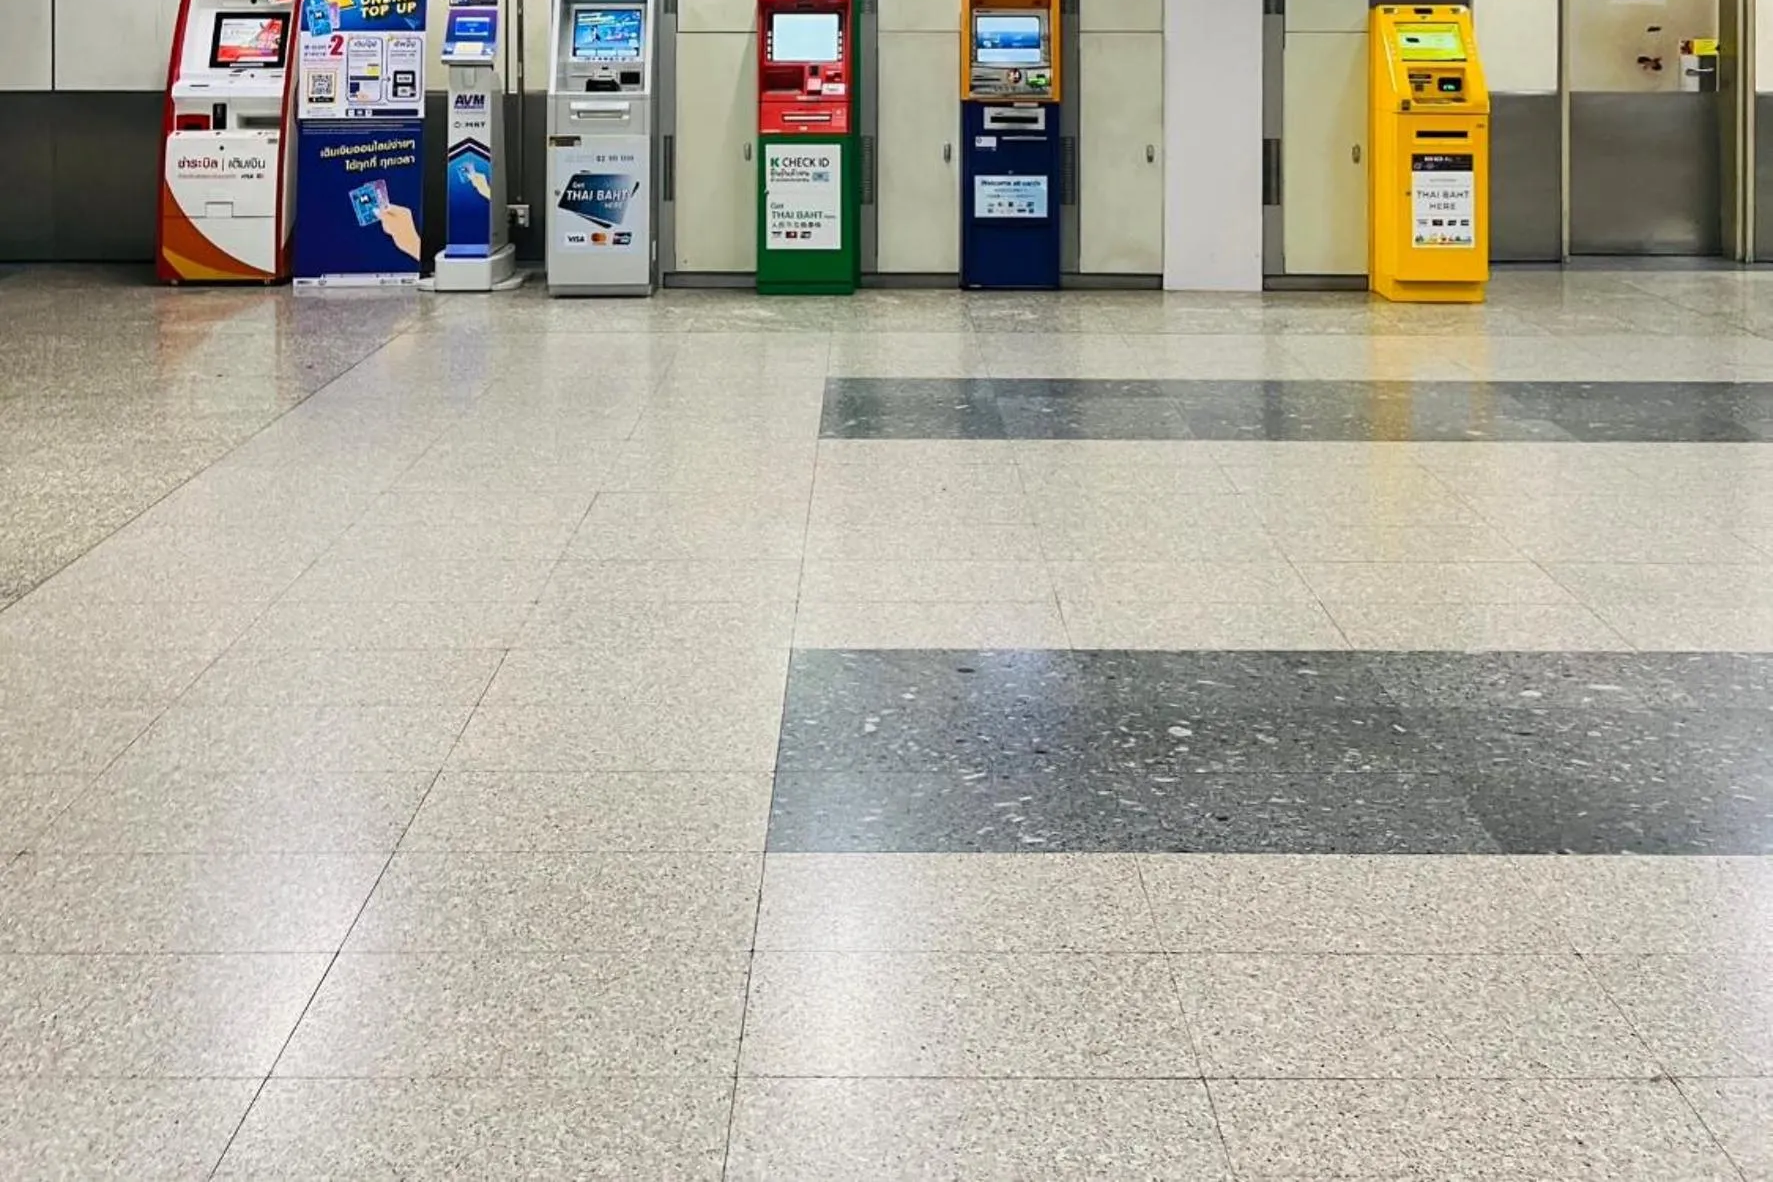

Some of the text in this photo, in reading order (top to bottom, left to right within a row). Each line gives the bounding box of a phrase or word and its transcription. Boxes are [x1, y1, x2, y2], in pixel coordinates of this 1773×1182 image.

[361, 1, 417, 18] TOP UP
[330, 35, 344, 56] 2
[454, 94, 486, 106] AVM
[177, 156, 267, 169] ชำระบิล เติมเงิน
[770, 157, 830, 167] K CHECK ID
[566, 189, 632, 201] THAI BAHT
[1416, 190, 1469, 198] THAI BAHT
[1429, 202, 1456, 210] HERE
[772, 210, 795, 219] THAI
[796, 210, 823, 219] BAHT
[567, 235, 585, 243] VISA
